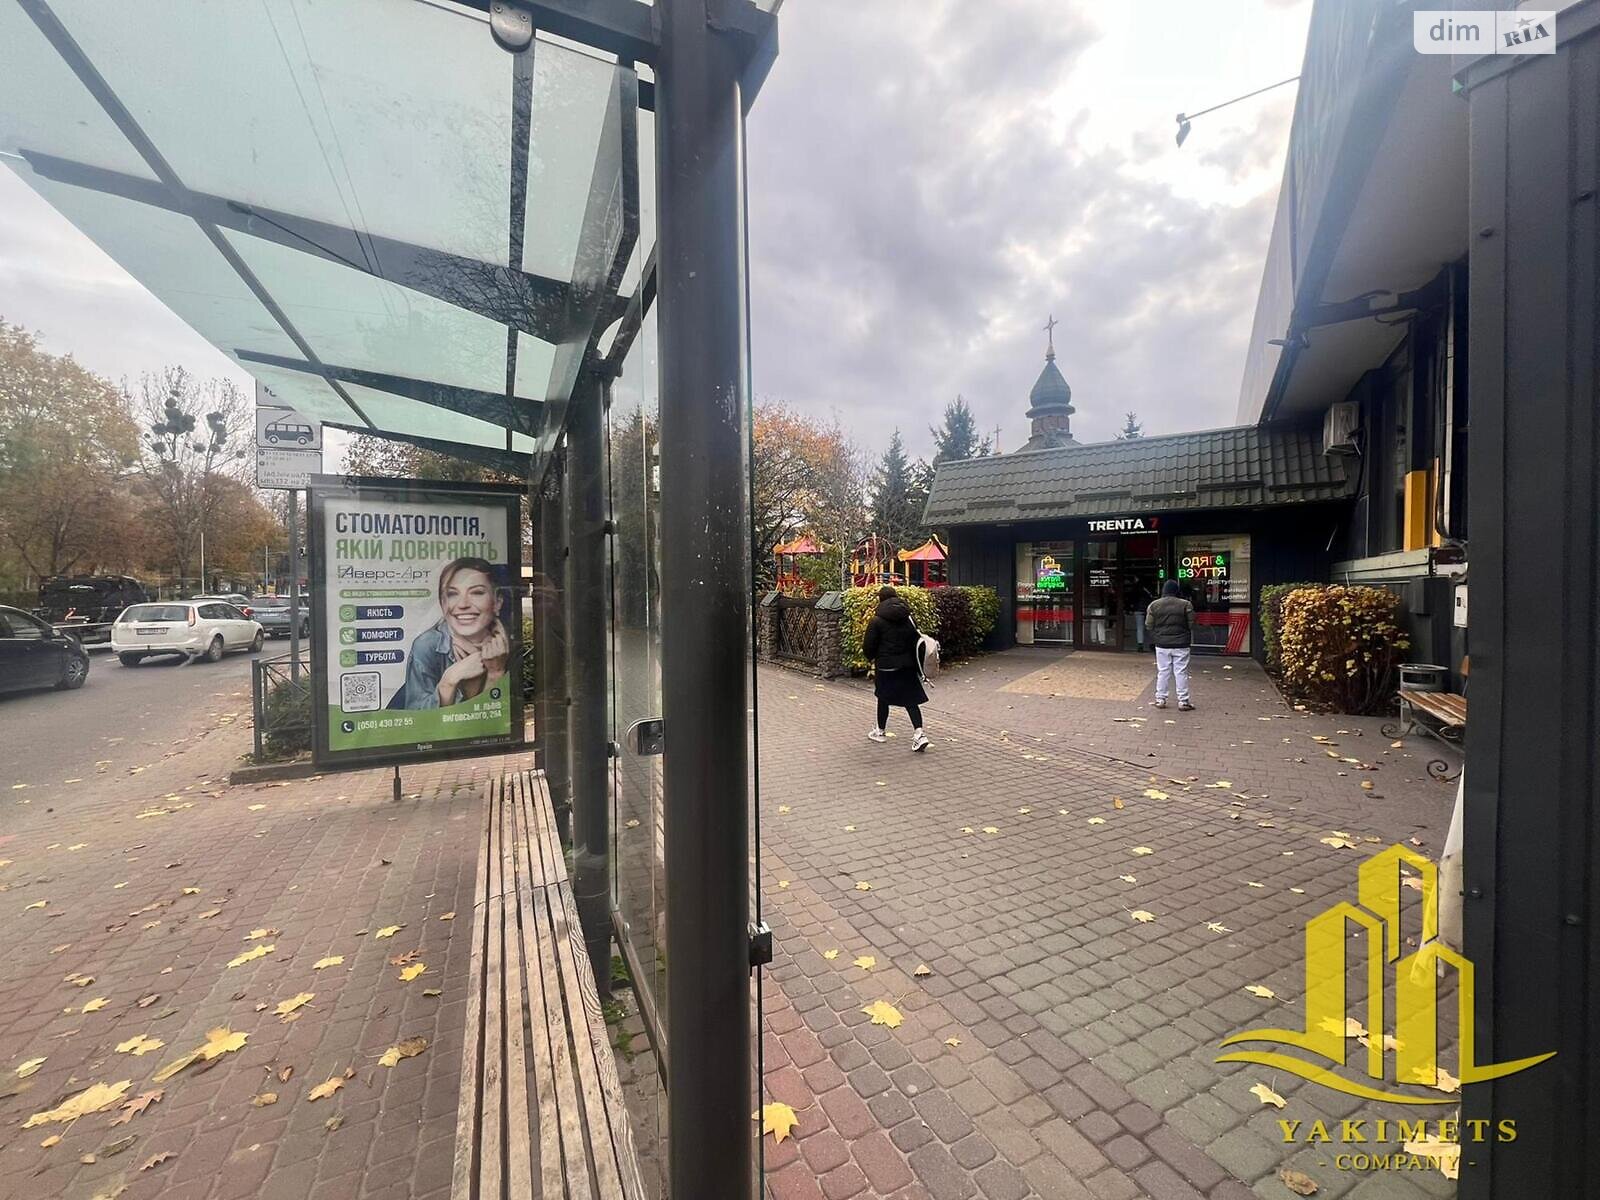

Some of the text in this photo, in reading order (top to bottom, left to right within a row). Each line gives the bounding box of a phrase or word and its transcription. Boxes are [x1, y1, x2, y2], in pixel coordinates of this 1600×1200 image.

[335, 512, 486, 539] СТОМАТОЛОГІЯ,
[1087, 517, 1159, 532] TRENTA 7
[335, 535, 498, 563] ЯКІЙ ДОВІРЯЮТЬ
[1178, 566, 1227, 578] ВЗУТТЯ
[366, 608, 393, 617] ЯКІСТЬ
[361, 630, 398, 640] КОМФОРТ
[364, 652, 397, 662] ТУРБОТА
